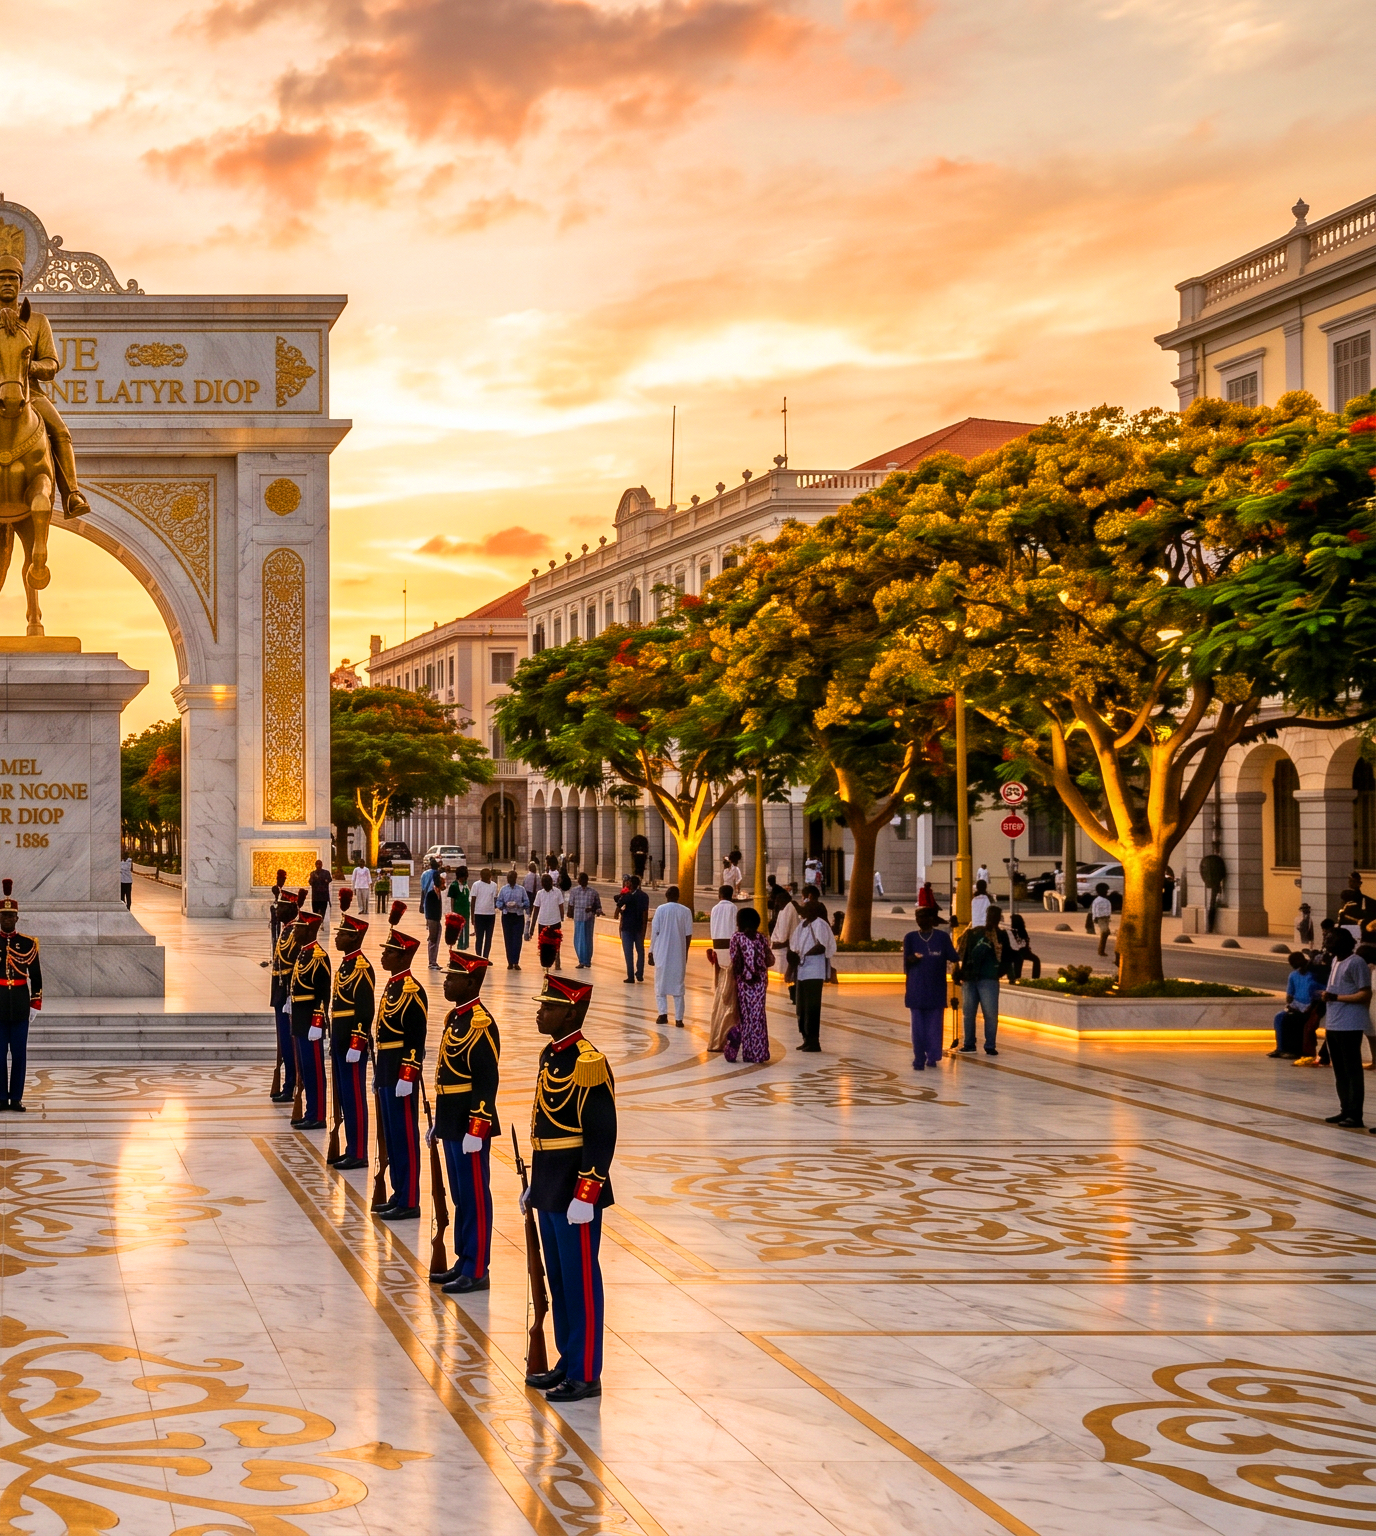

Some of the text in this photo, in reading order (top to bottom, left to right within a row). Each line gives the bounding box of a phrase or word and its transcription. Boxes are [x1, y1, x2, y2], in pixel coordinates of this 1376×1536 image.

[95, 379, 188, 404] LATYR
[193, 379, 261, 404] DIOP
[19, 783, 88, 800] NGONE
[18, 808, 64, 824] DIOP
[15, 833, 49, 848] 1886
